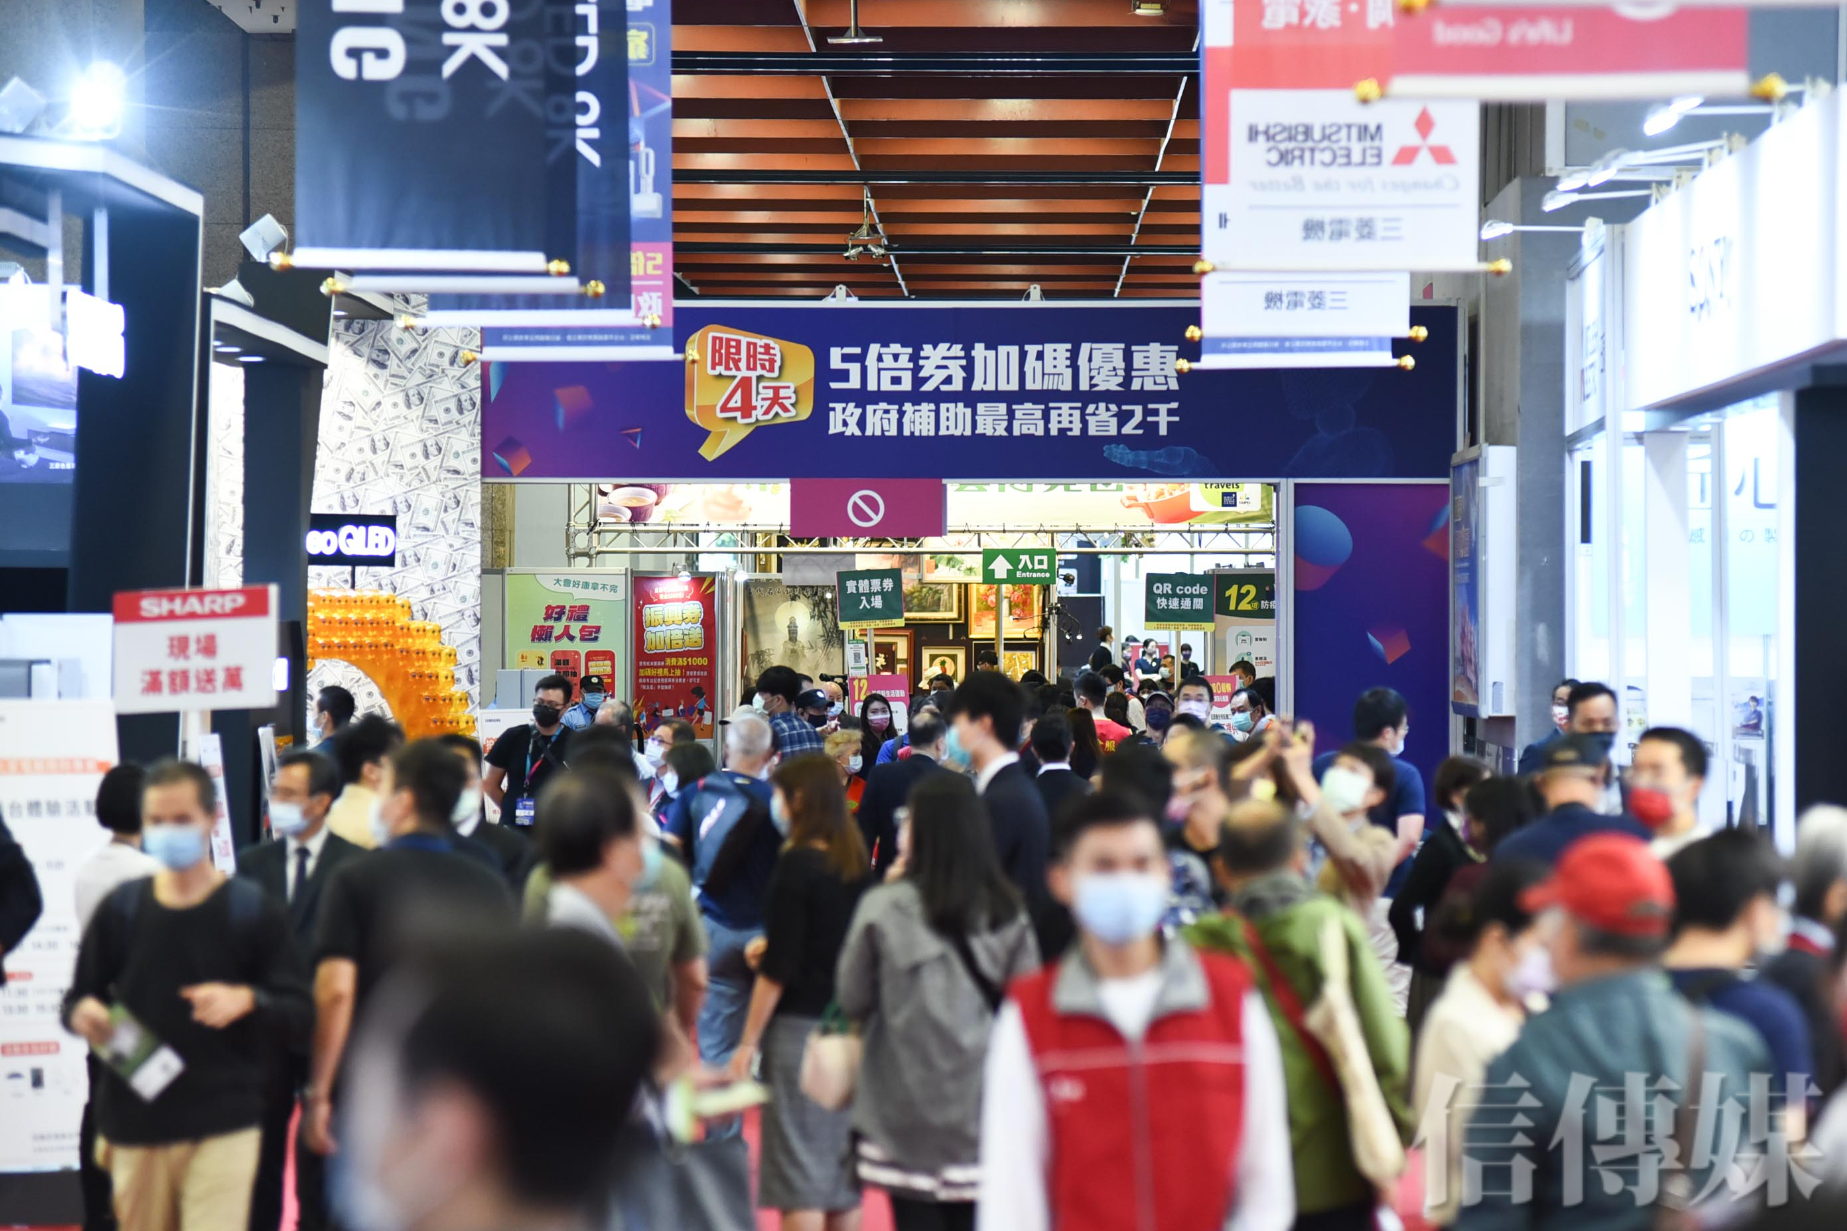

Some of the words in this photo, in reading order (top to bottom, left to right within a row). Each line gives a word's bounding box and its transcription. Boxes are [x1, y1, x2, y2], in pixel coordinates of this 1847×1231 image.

[710, 335, 777, 374] 限時
[829, 342, 1180, 391] 5倍券加碼優惠
[719, 375, 793, 420] 4天
[828, 401, 1180, 436] 政府補助最高再省2千
[339, 525, 395, 556] QLED
[1018, 554, 1048, 570] 入口
[553, 577, 618, 593] 大會好康拿不完
[845, 578, 894, 595] 實體票券
[1153, 583, 1172, 595] QR
[1176, 584, 1208, 594] code
[1225, 584, 1257, 611] 12
[139, 593, 246, 618] SHARP
[542, 604, 591, 623] 好禮
[645, 602, 702, 628] 振興券
[859, 595, 883, 610] 入場
[1156, 597, 1204, 610] 快速通關
[530, 624, 602, 644] 懶人包
[168, 633, 217, 661] 現場
[140, 665, 243, 696] 滿額送萬
[853, 678, 868, 701] 12
